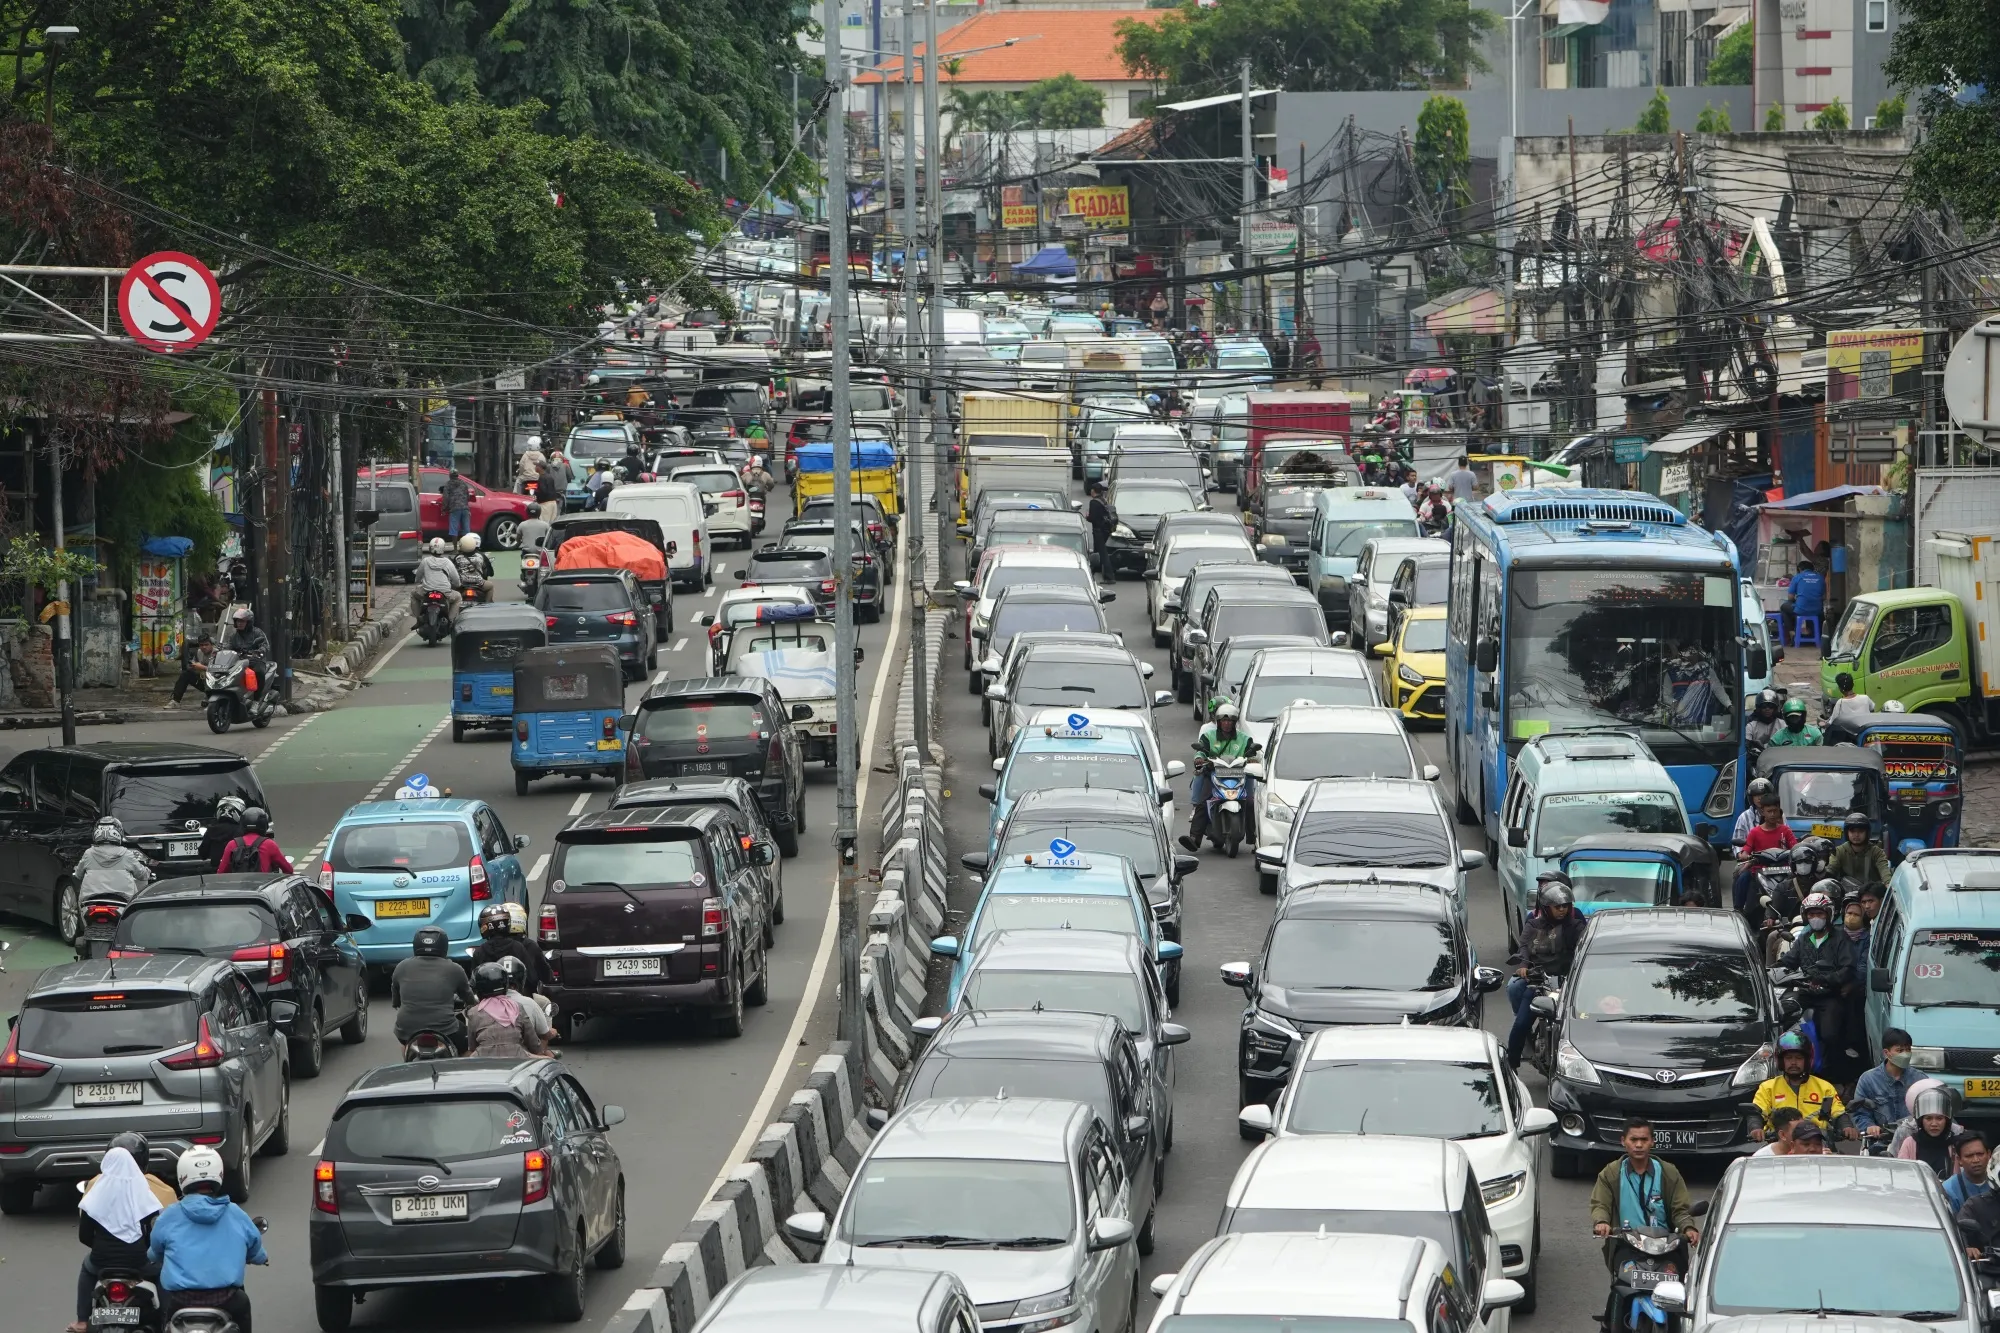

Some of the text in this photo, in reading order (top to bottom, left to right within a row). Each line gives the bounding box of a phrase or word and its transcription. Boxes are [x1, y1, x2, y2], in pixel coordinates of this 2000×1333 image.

[1075, 193, 1126, 217] GADAI
[1833, 333, 1919, 348] ARYAN CARPETS
[1880, 662, 1960, 679] DILARANG MENUMPANG
[696, 763, 712, 772] 1603
[1549, 795, 1584, 804] BENHIL
[170, 843, 175, 852] B
[1047, 858, 1080, 866] TAKSI
[421, 876, 439, 884] SDD
[1031, 896, 1084, 904] Bluebird
[379, 900, 426, 911] B 2225 BUA
[1929, 933, 1979, 941] BENHIL
[605, 959, 659, 971] B 2439 SBQ
[1914, 963, 1944, 978] 03
[77, 1082, 138, 1096] B 2316 TZK
[1967, 1081, 1973, 1091] B
[1676, 1131, 1695, 1144] KKW
[394, 1195, 465, 1212] B 2010 UKM
[1633, 1271, 1638, 1279] B
[1641, 1273, 1660, 1281] 6554
